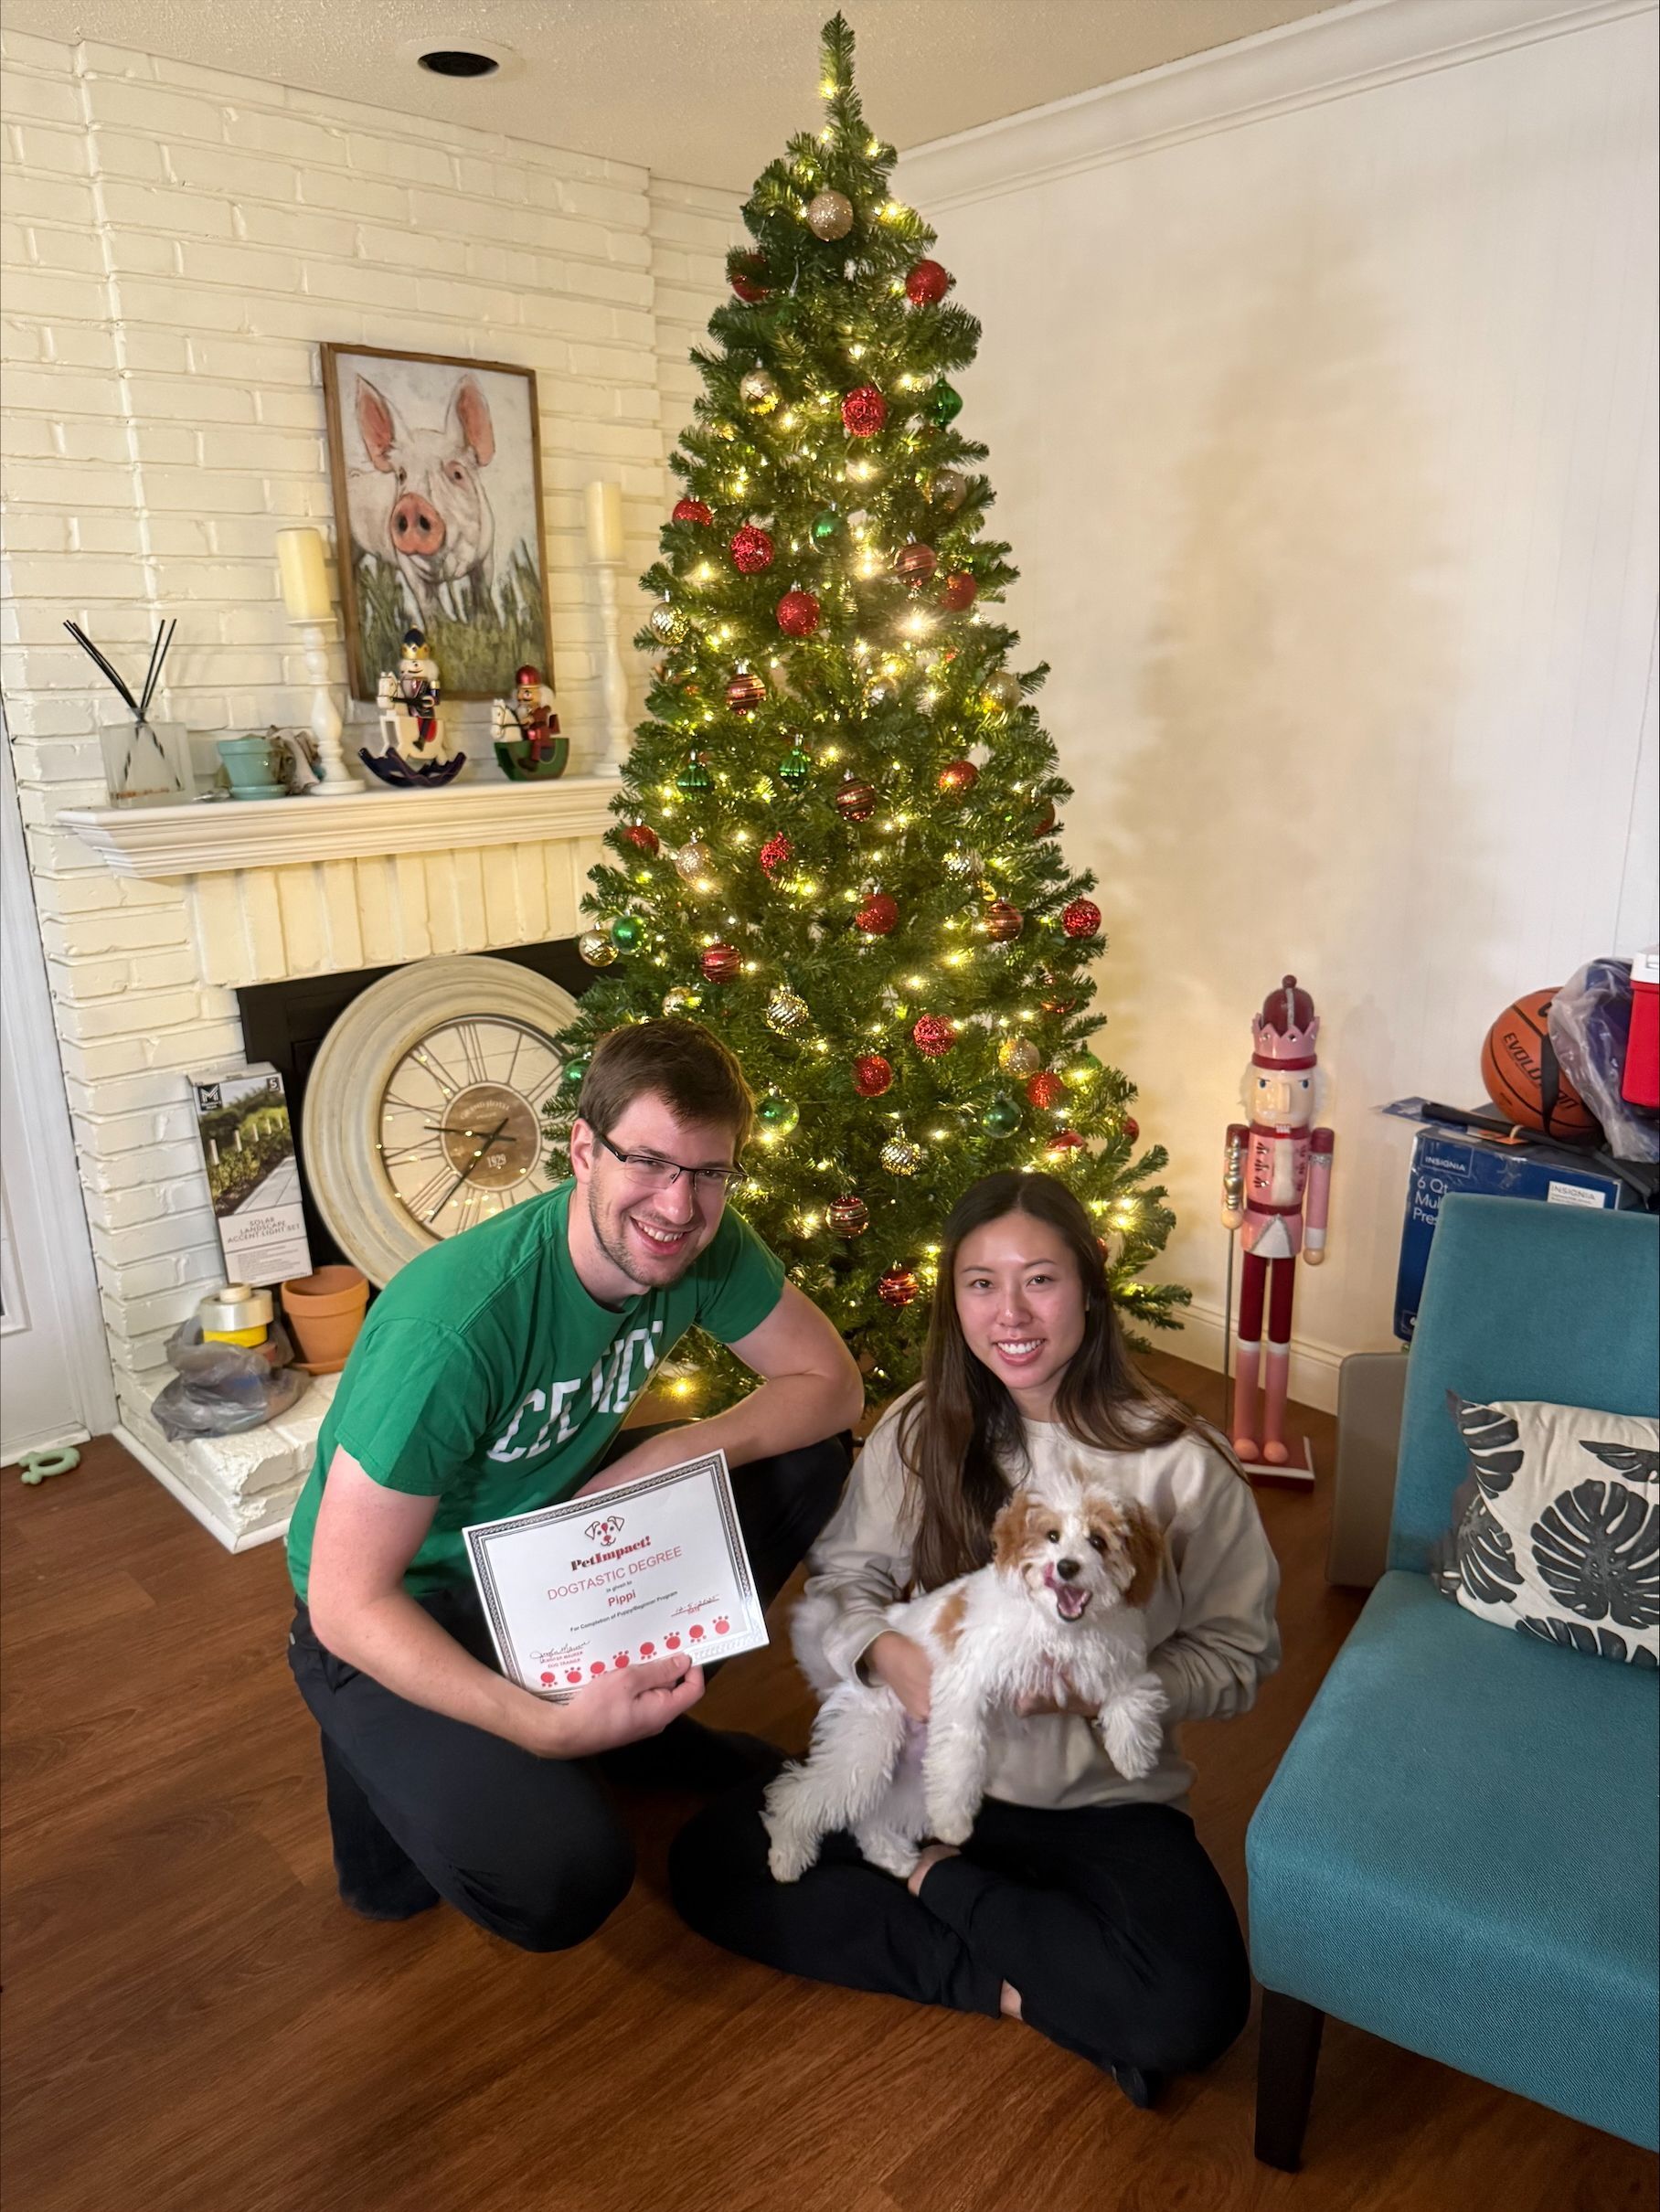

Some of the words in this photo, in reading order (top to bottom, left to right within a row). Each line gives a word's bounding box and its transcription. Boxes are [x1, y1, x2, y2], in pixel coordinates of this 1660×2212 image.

[486, 1154, 506, 1168] 1929
[1425, 1156, 1466, 1172] INSIGNIA
[1418, 1175, 1426, 1189] 6
[1430, 1177, 1449, 1195] Qt
[1551, 1185, 1596, 1200] INSIGNIA
[239, 1220, 286, 1235] LANDSCAPE
[250, 1217, 275, 1227] SOLAR
[227, 1231, 260, 1243] ACCENT
[261, 1227, 285, 1238] LIGHT
[287, 1223, 301, 1232] SET
[570, 1536, 652, 1571] PetImpact!
[548, 1567, 626, 1601] DOGTASTIC
[628, 1546, 683, 1575] DEGREE
[608, 1589, 636, 1607] Pippi
[580, 1616, 611, 1629] Completion
[657, 1590, 678, 1602] Program
